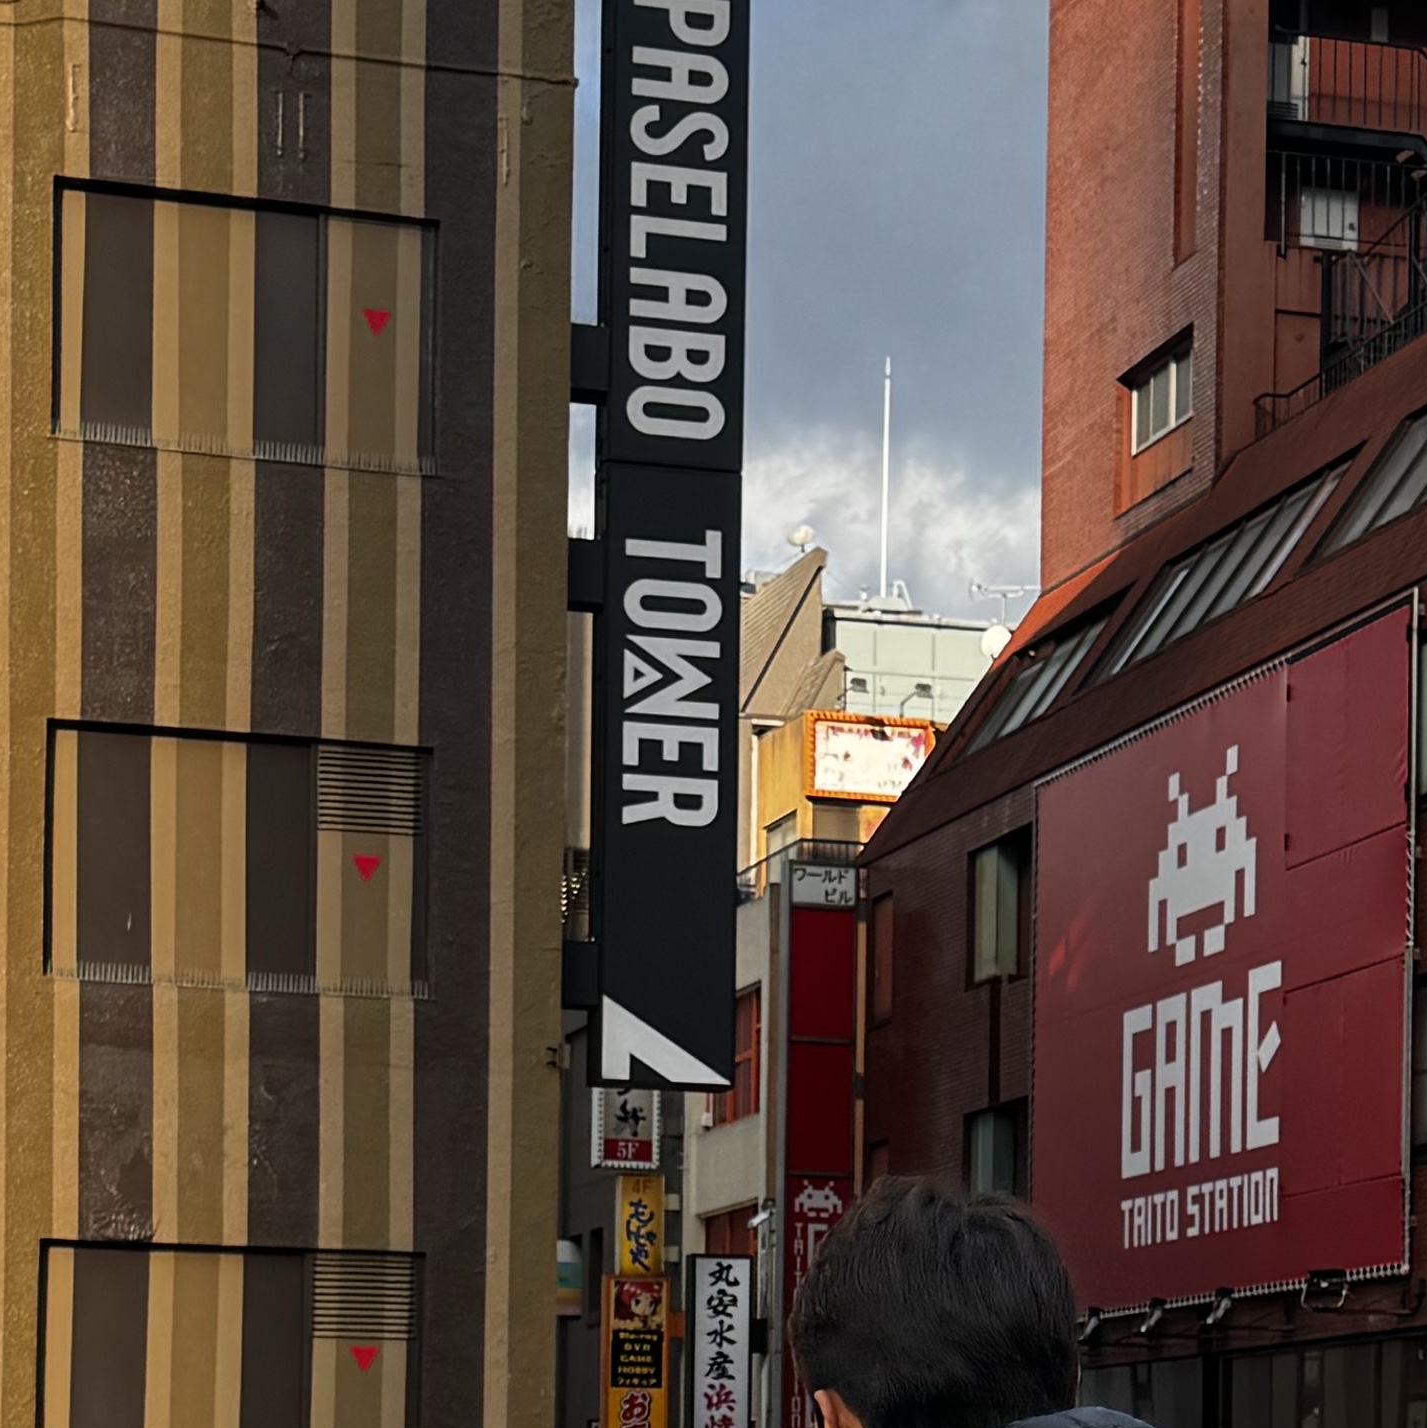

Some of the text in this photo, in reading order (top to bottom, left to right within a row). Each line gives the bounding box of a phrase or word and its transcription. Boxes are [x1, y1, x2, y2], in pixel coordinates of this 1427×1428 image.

[621, 0, 730, 828] PASELABO TOWER
[794, 868, 850, 884] ワールド
[825, 888, 853, 904] ビル
[1121, 960, 1282, 1180] GAME
[617, 1143, 638, 1159] 5F
[1121, 1167, 1279, 1250] TAITO STATION
